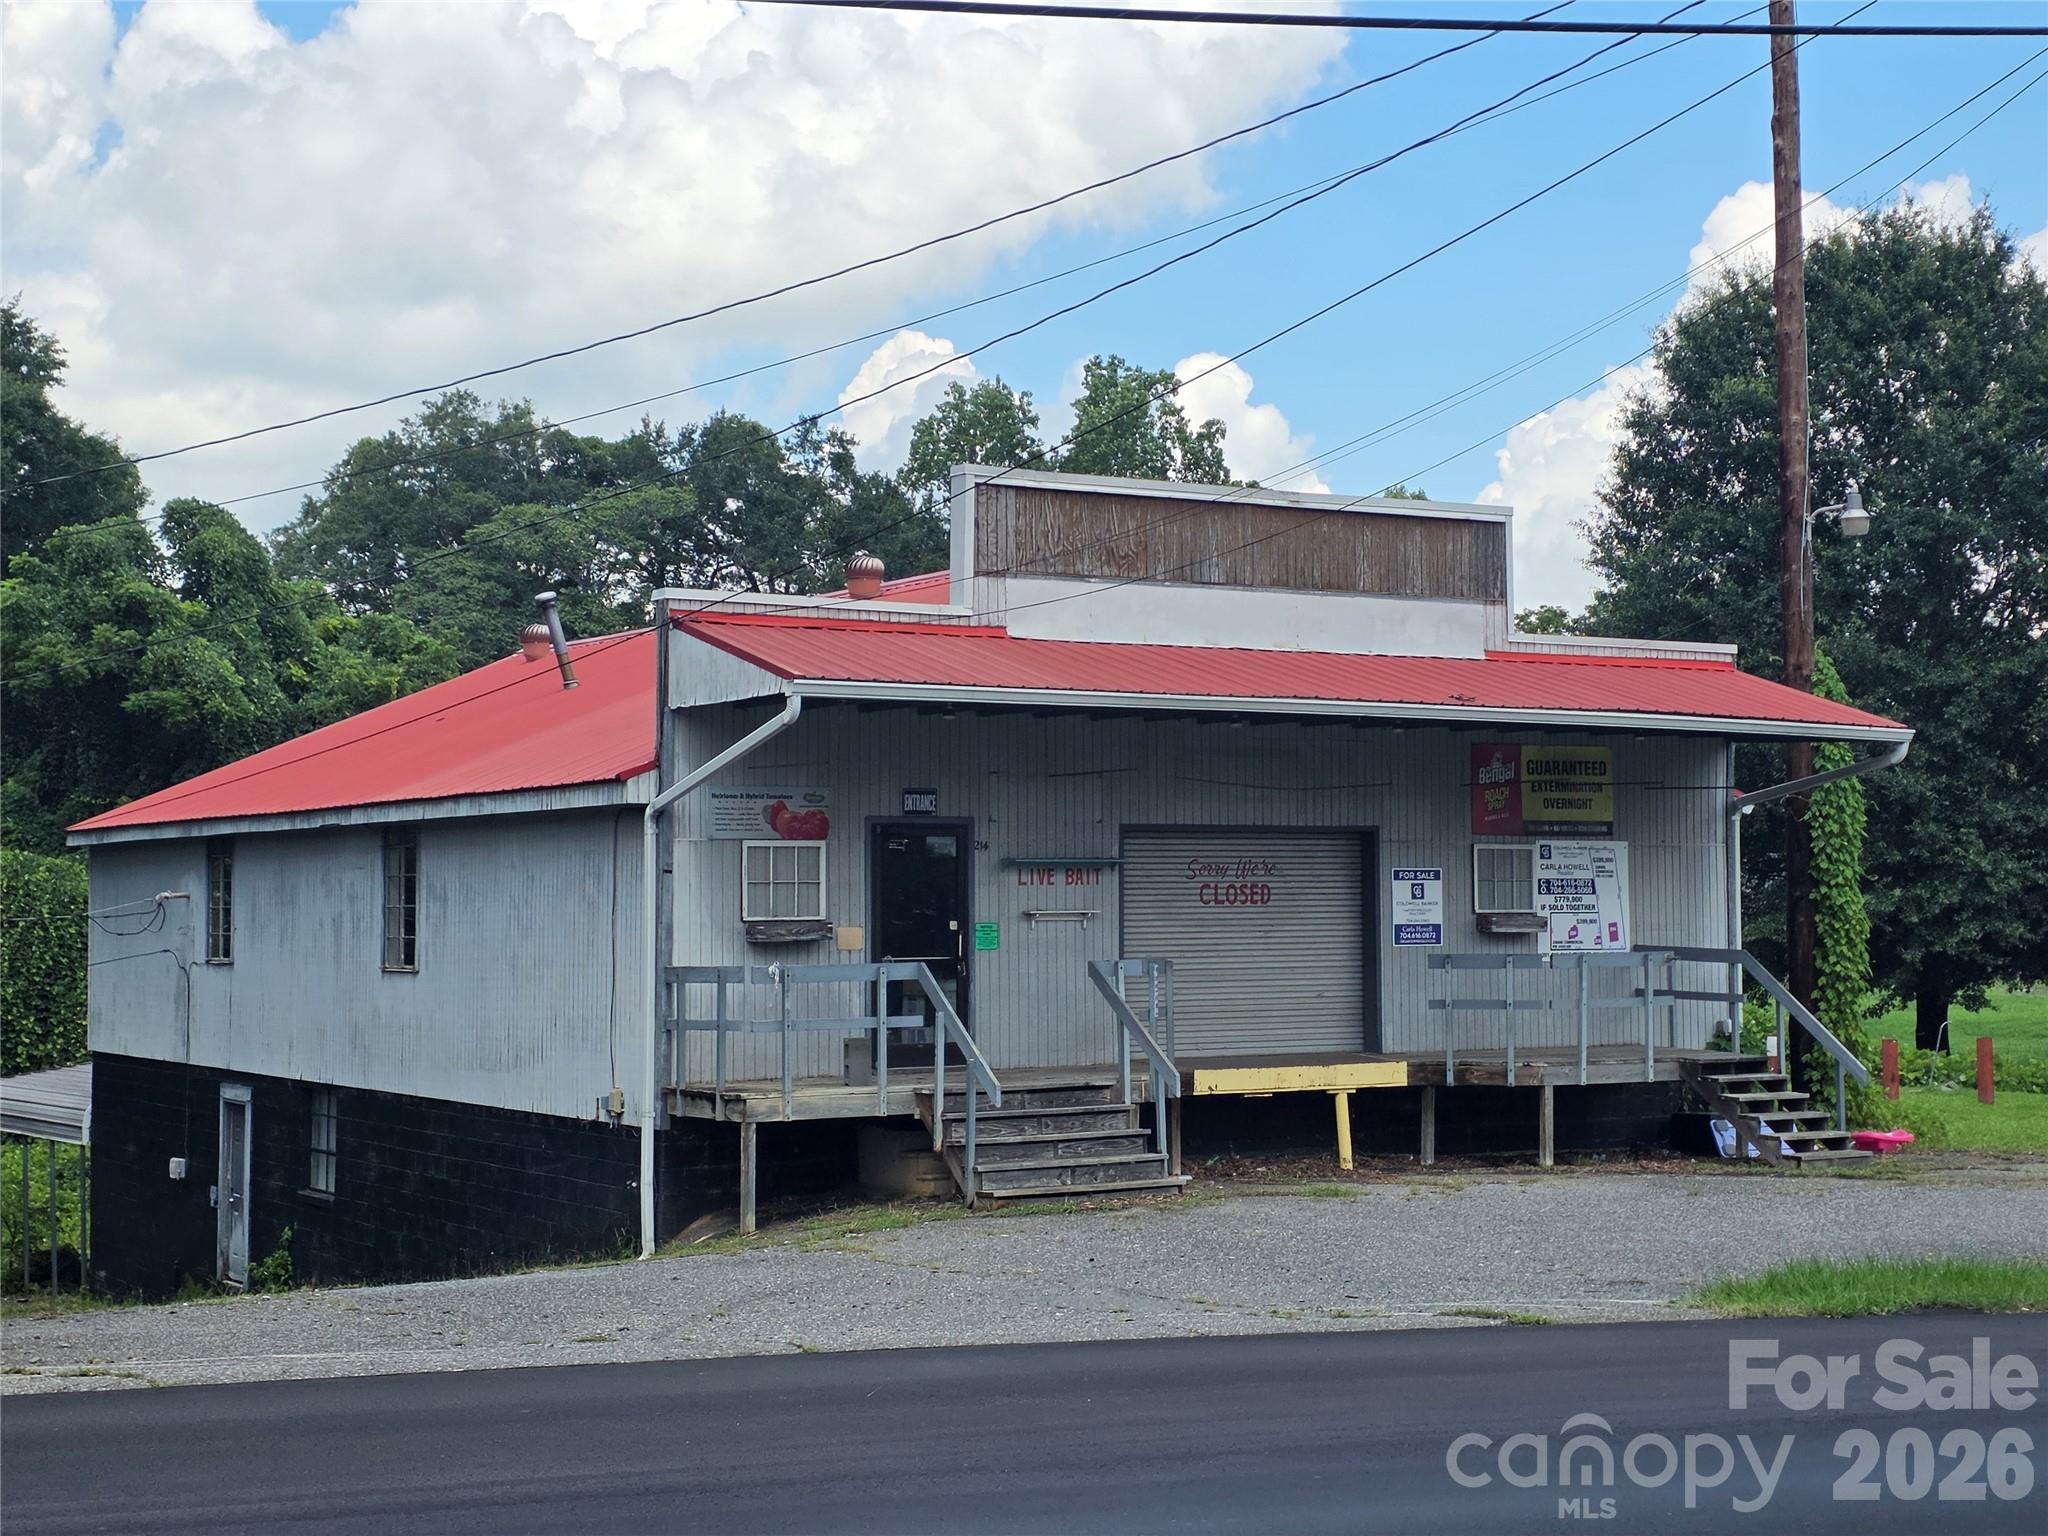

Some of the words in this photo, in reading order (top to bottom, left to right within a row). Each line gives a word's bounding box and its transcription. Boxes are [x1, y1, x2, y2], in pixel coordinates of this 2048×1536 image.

[1478, 760, 1515, 785] Bengal
[1526, 759, 1607, 777] GUARANTEED
[1484, 786, 1509, 803] ROACH
[1531, 781, 1604, 793] EXTERMINATION
[904, 794, 936, 811] ENTRANCE
[1543, 798, 1594, 810] OVERNIGHT
[974, 841, 989, 852] 214
[1018, 868, 1056, 886] LIVE
[1065, 867, 1103, 886] BAIT
[1185, 858, 1230, 880] Sorry
[1234, 858, 1276, 880] We're
[1200, 883, 1271, 905] CLOSED
